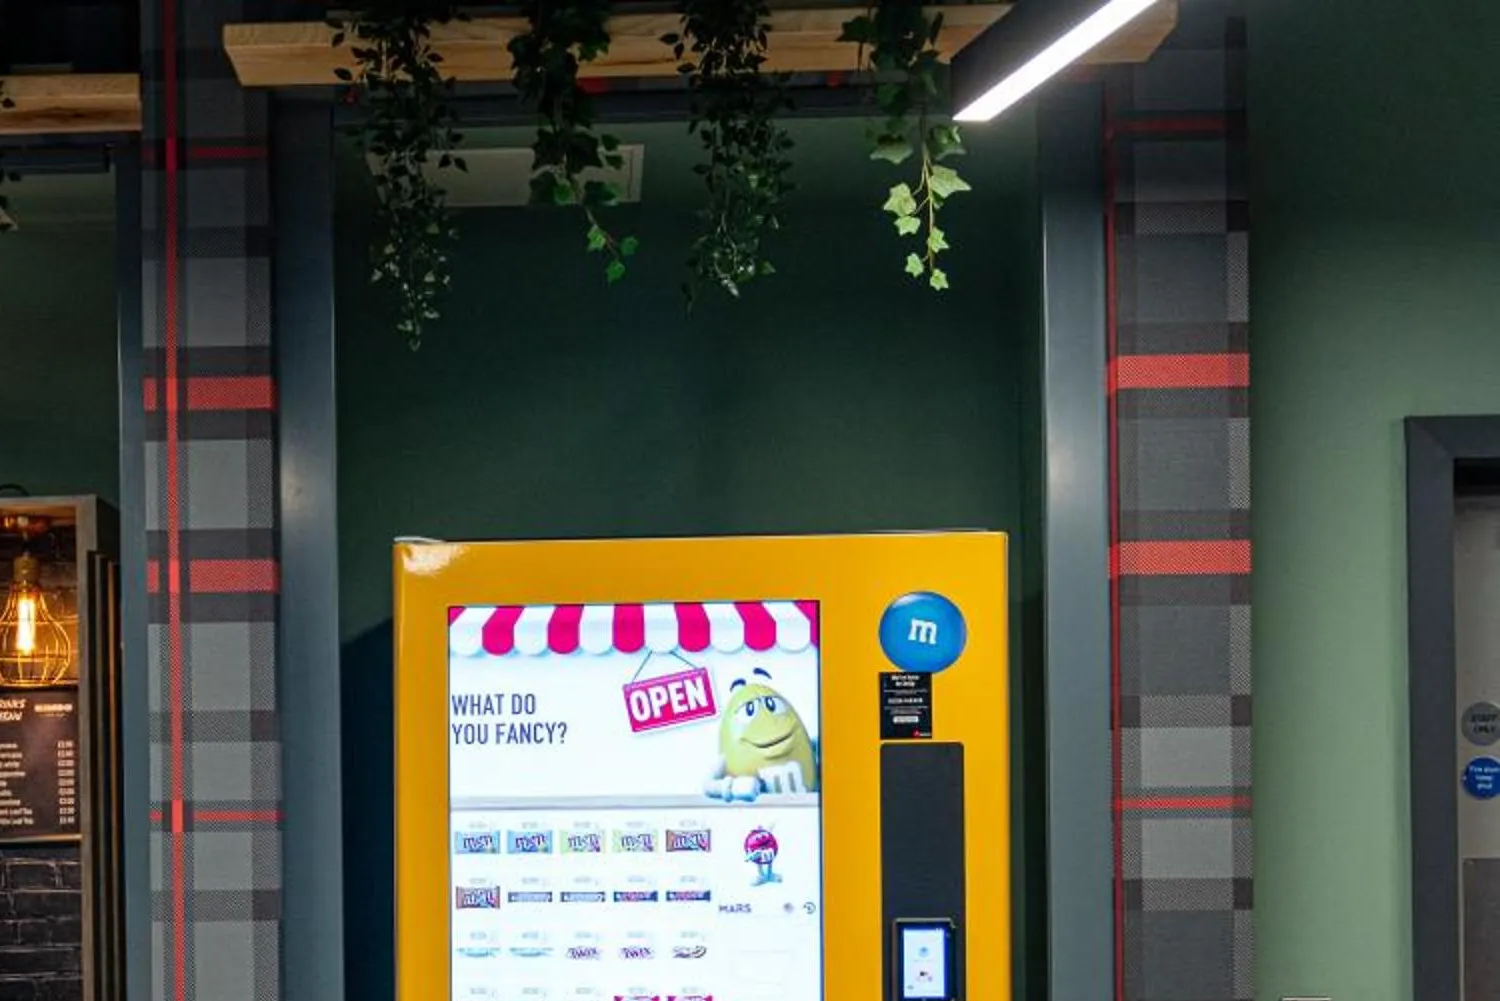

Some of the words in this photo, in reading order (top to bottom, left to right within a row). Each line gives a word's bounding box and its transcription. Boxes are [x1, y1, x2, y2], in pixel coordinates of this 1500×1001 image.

[908, 618, 937, 645] m
[451, 694, 504, 716] WHAT
[511, 694, 536, 715] DO
[628, 676, 709, 723] OPEN
[451, 723, 489, 745] YOU
[495, 722, 568, 744] FANCY?
